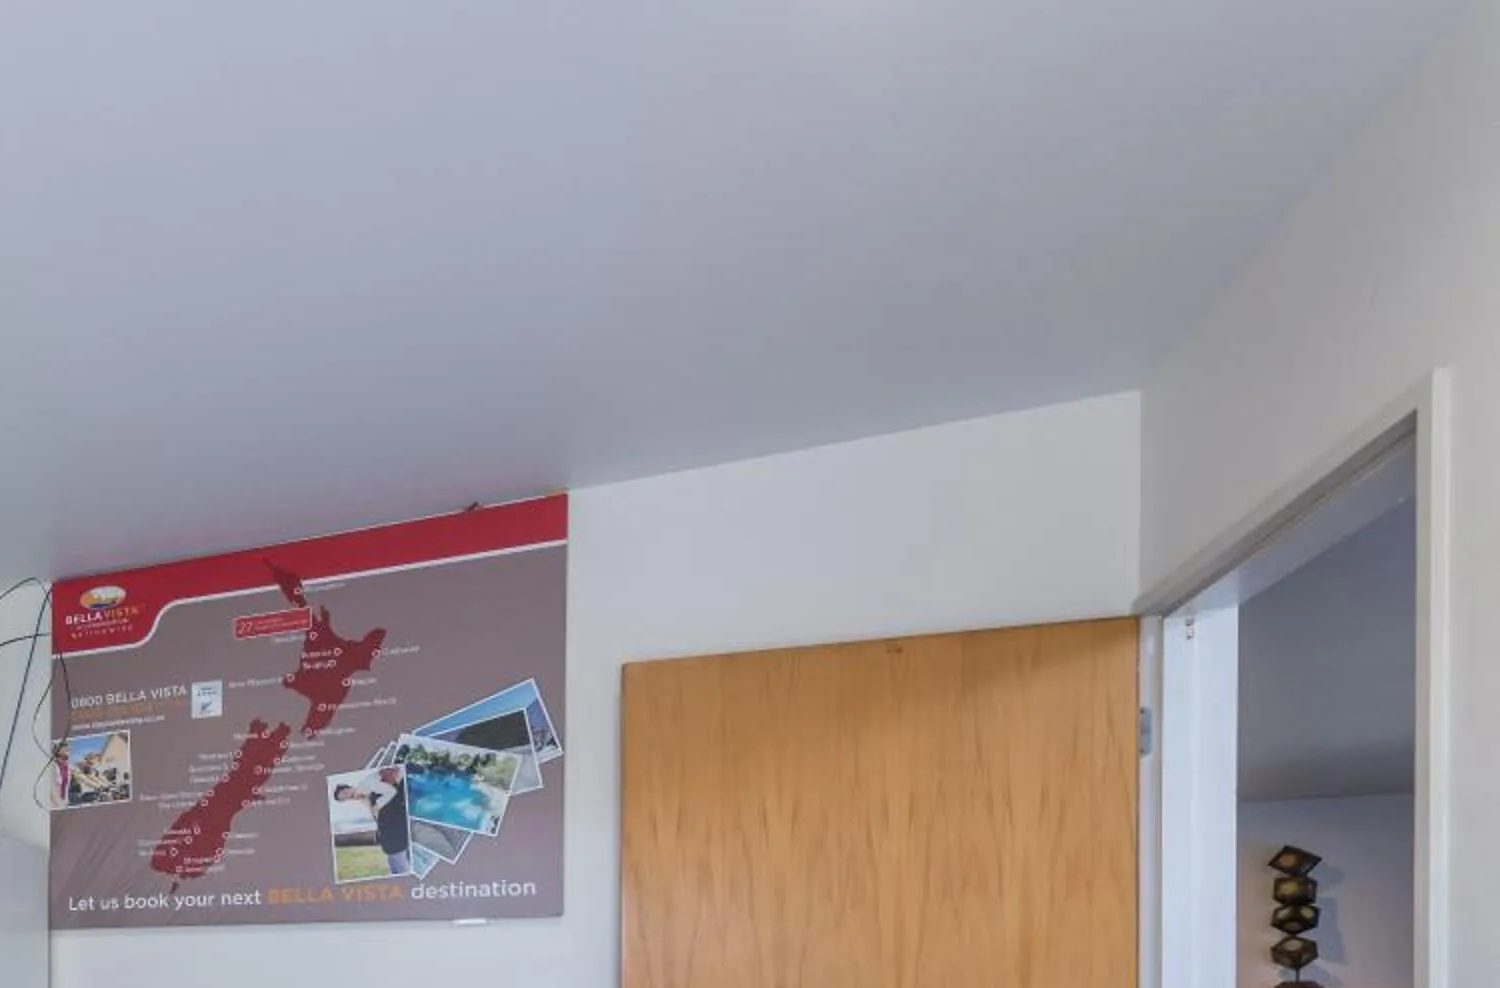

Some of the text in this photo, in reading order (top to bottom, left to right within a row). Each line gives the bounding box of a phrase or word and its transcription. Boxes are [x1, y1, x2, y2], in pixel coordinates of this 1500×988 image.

[105, 691, 147, 705] BELLA
[150, 685, 188, 700] VISTA
[68, 880, 536, 911] Let us book your next BELLA VISTA destination
